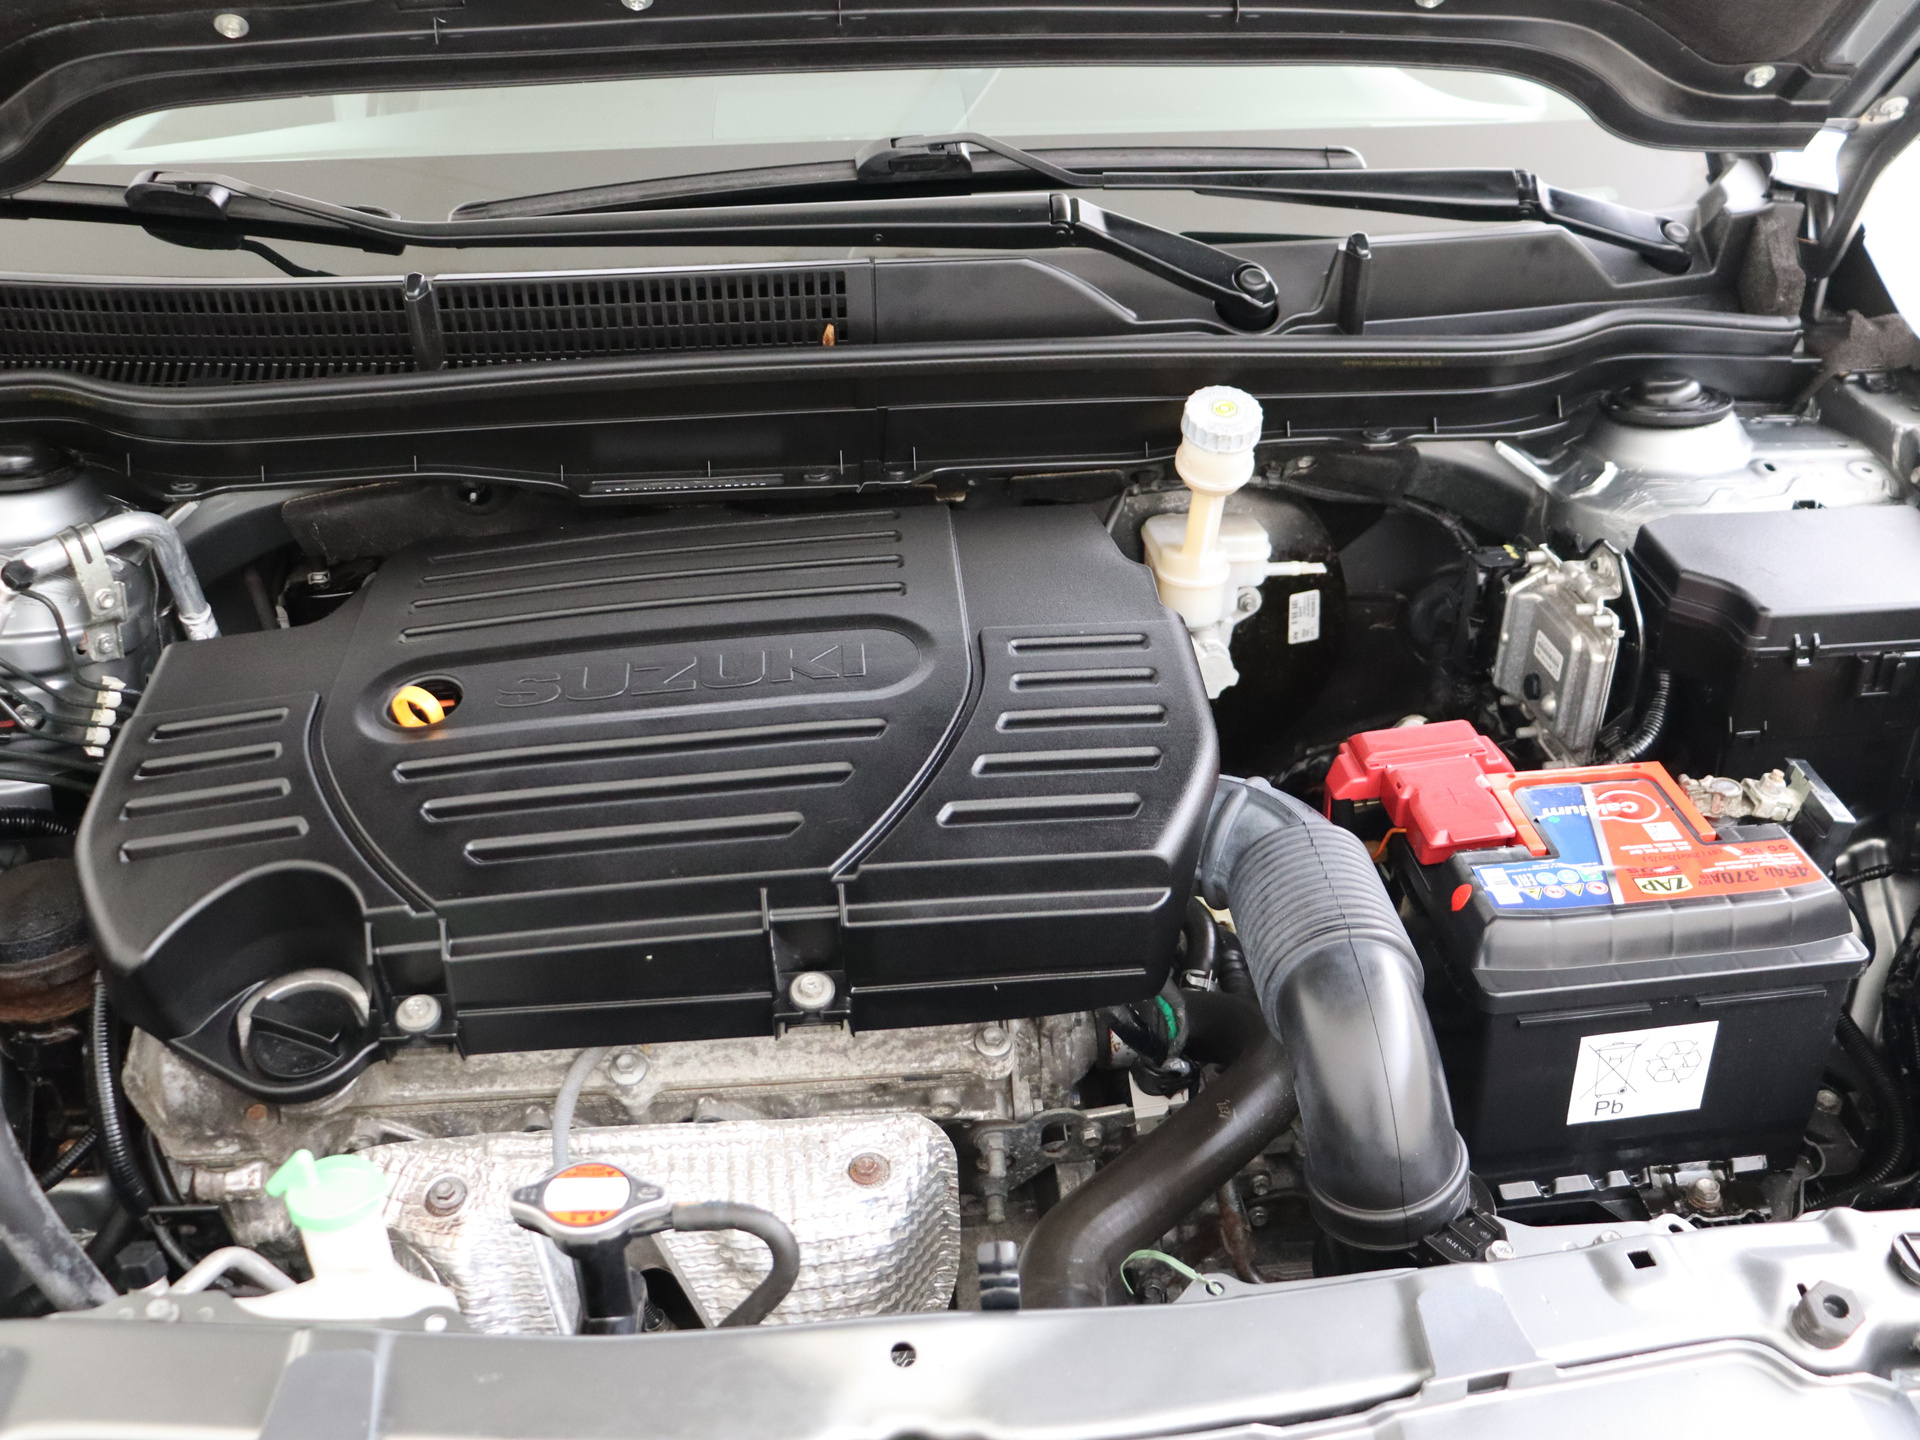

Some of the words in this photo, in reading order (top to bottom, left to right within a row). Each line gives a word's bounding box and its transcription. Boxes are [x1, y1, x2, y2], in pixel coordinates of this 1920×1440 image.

[495, 643, 866, 708] SUZUKI
[1711, 870, 1759, 884] 370A
[1763, 866, 1809, 879] 45Ah
[1641, 877, 1689, 891] ZAP
[1594, 1099, 1624, 1116] Pb
